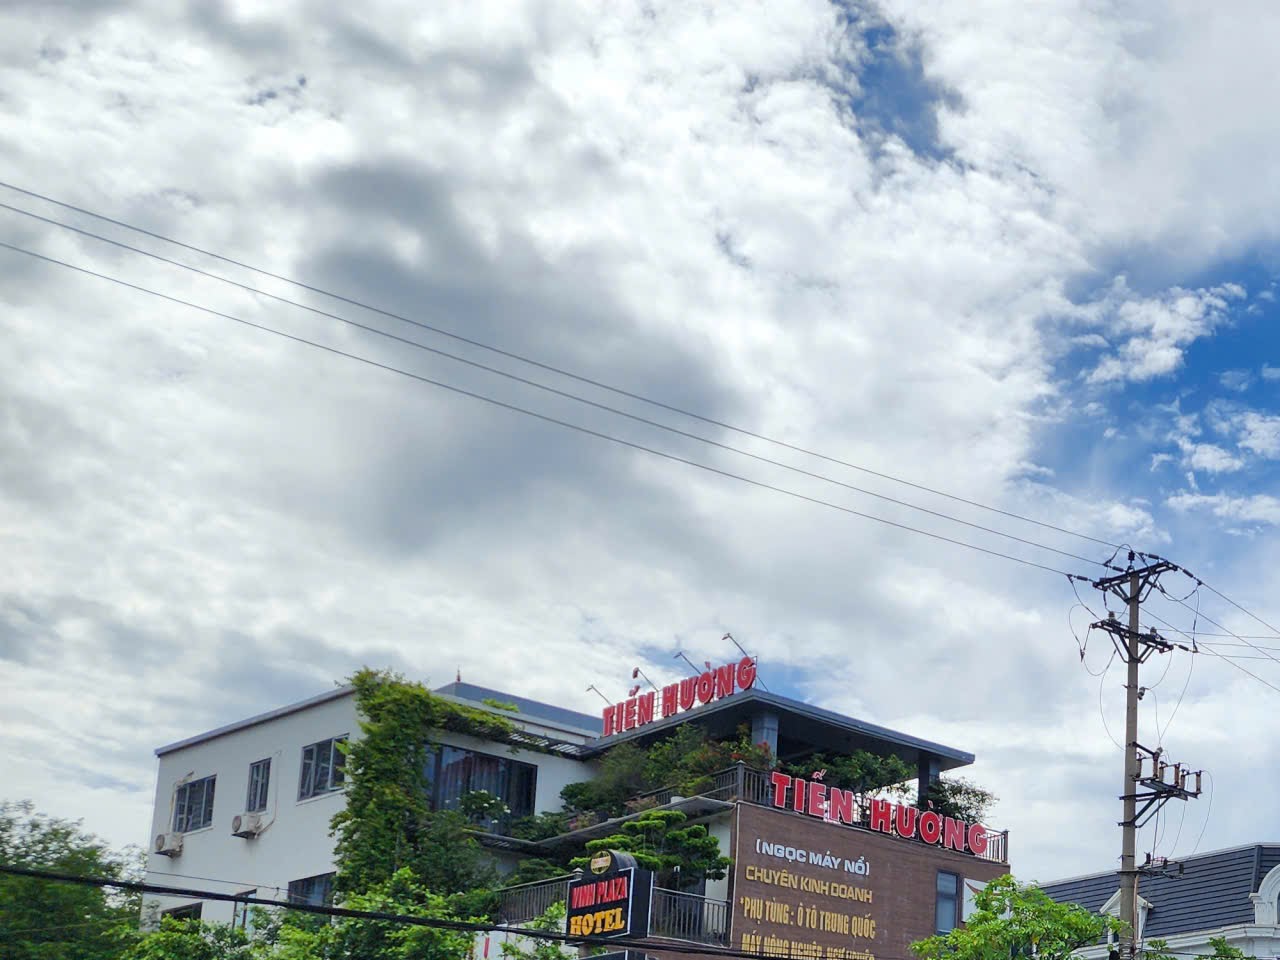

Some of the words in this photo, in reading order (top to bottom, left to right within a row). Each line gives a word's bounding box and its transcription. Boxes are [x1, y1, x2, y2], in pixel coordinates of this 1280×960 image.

[808, 850, 842, 870] MÁY
[745, 866, 798, 889] CHUYÊN
[800, 876, 829, 897] KINH
[830, 883, 873, 903] DOANH
[570, 908, 626, 937] HOTEL
[806, 904, 818, 929] TÔ
[820, 911, 849, 935] TRUNG
[851, 912, 876, 939] QUỐC
